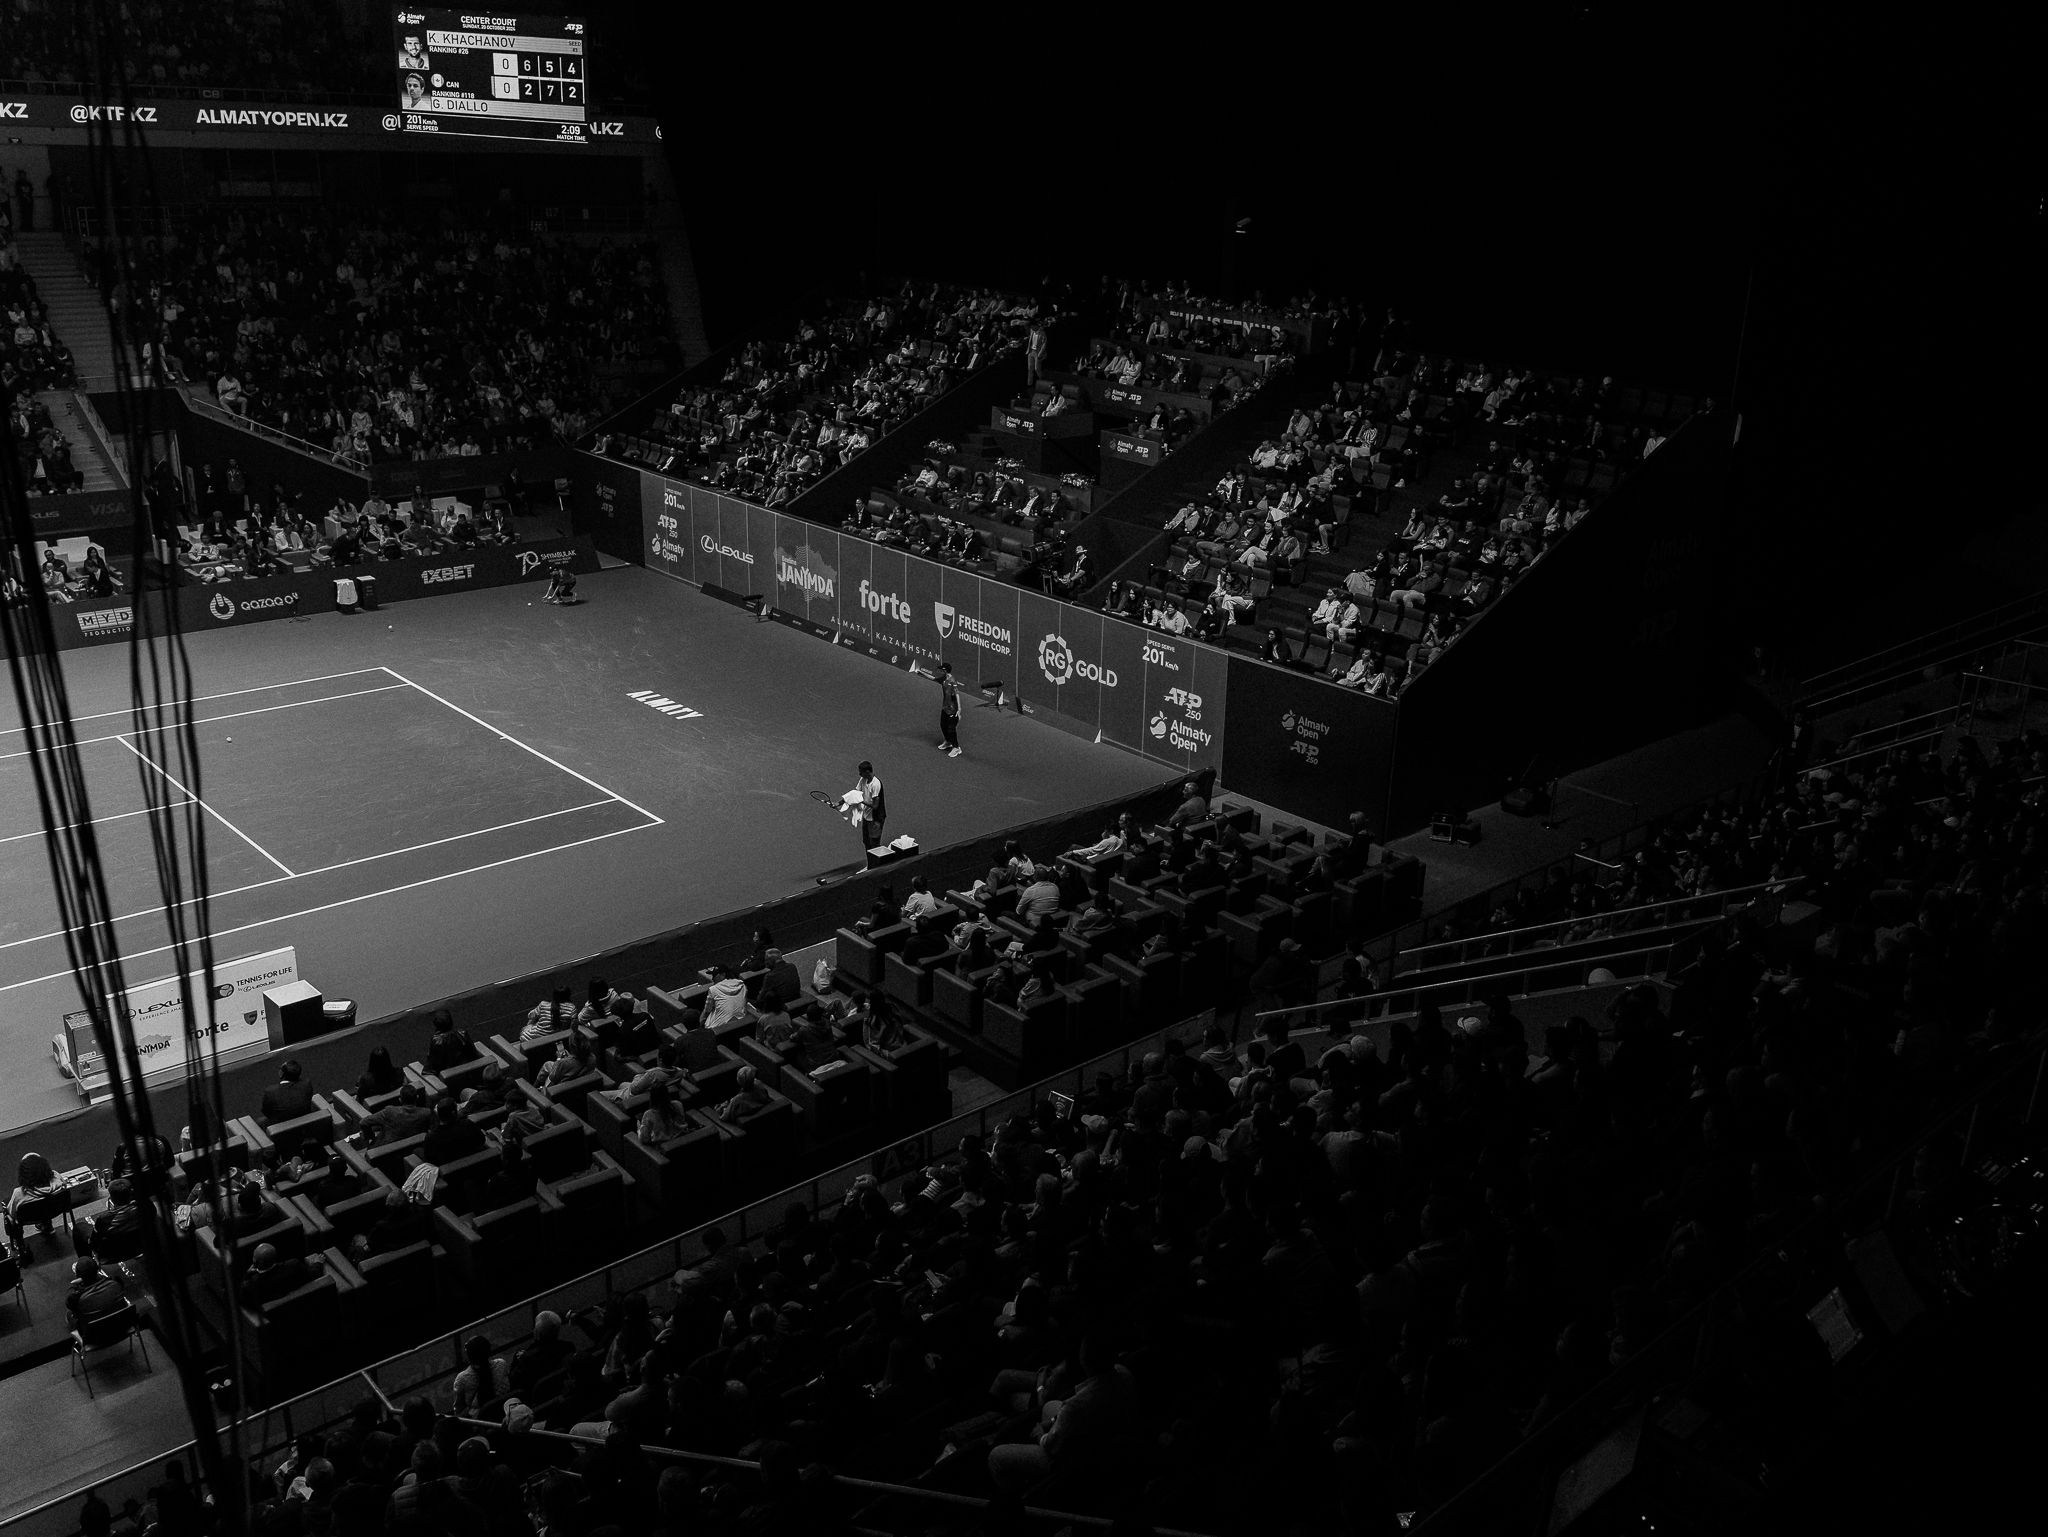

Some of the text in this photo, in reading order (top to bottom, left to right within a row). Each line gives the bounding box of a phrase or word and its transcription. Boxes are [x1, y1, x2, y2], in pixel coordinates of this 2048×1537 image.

[406, 13, 425, 21] Almaty
[460, 15, 517, 27] CENTER COURT
[564, 23, 583, 31] ATP
[428, 32, 516, 48] K. KHACHANOV
[428, 45, 458, 54] RANKING
[502, 58, 510, 70] 0
[523, 60, 532, 72] 6
[545, 61, 554, 73] 5
[567, 62, 576, 75] 4
[445, 81, 460, 89] CAN
[503, 82, 511, 94] 0
[524, 83, 533, 96] 2
[547, 85, 554, 97] 7
[568, 86, 577, 99] 2
[431, 90, 460, 99] RANKING
[432, 98, 489, 113] G. DIALLO
[70, 105, 158, 123] @KTFKZ
[196, 108, 349, 128] ALMATYOPEN.KZ
[406, 114, 423, 125] 201
[406, 124, 422, 132] SERVE
[560, 125, 581, 135] 2:09
[663, 492, 677, 508] 201
[89, 502, 127, 516] VISA
[657, 513, 678, 530] ATP
[662, 538, 685, 557] Almaty
[662, 547, 679, 563] Open
[714, 542, 755, 565] LEXUS
[421, 563, 476, 585] 1XBET
[776, 561, 835, 598] JANYMDA
[859, 579, 912, 624] forte
[82, 611, 130, 626] MYD
[83, 626, 132, 637] PRODUCTIO
[958, 613, 1012, 644] FREEDOM
[830, 615, 942, 661] ALMATY, KAZAKHSTAN
[958, 630, 1013, 657] HOLDING CORP.
[1146, 639, 1176, 653] SPEED SERVE
[1045, 648, 1066, 669] RG
[1142, 645, 1180, 672] 201 Km/h
[1075, 659, 1119, 688] GOLD
[625, 690, 704, 720] ALMATY
[1163, 686, 1203, 710] ATP
[1185, 708, 1203, 721] 250
[1170, 719, 1212, 747] Almaty
[1297, 724, 1320, 741] Open
[1298, 715, 1331, 736] Almaty
[1169, 731, 1198, 753] Open
[1290, 740, 1320, 757] ATP
[236, 974, 263, 987] TENNIS
[263, 970, 278, 980] FOR
[278, 966, 293, 976] LIFE
[189, 1021, 230, 1041] orte
